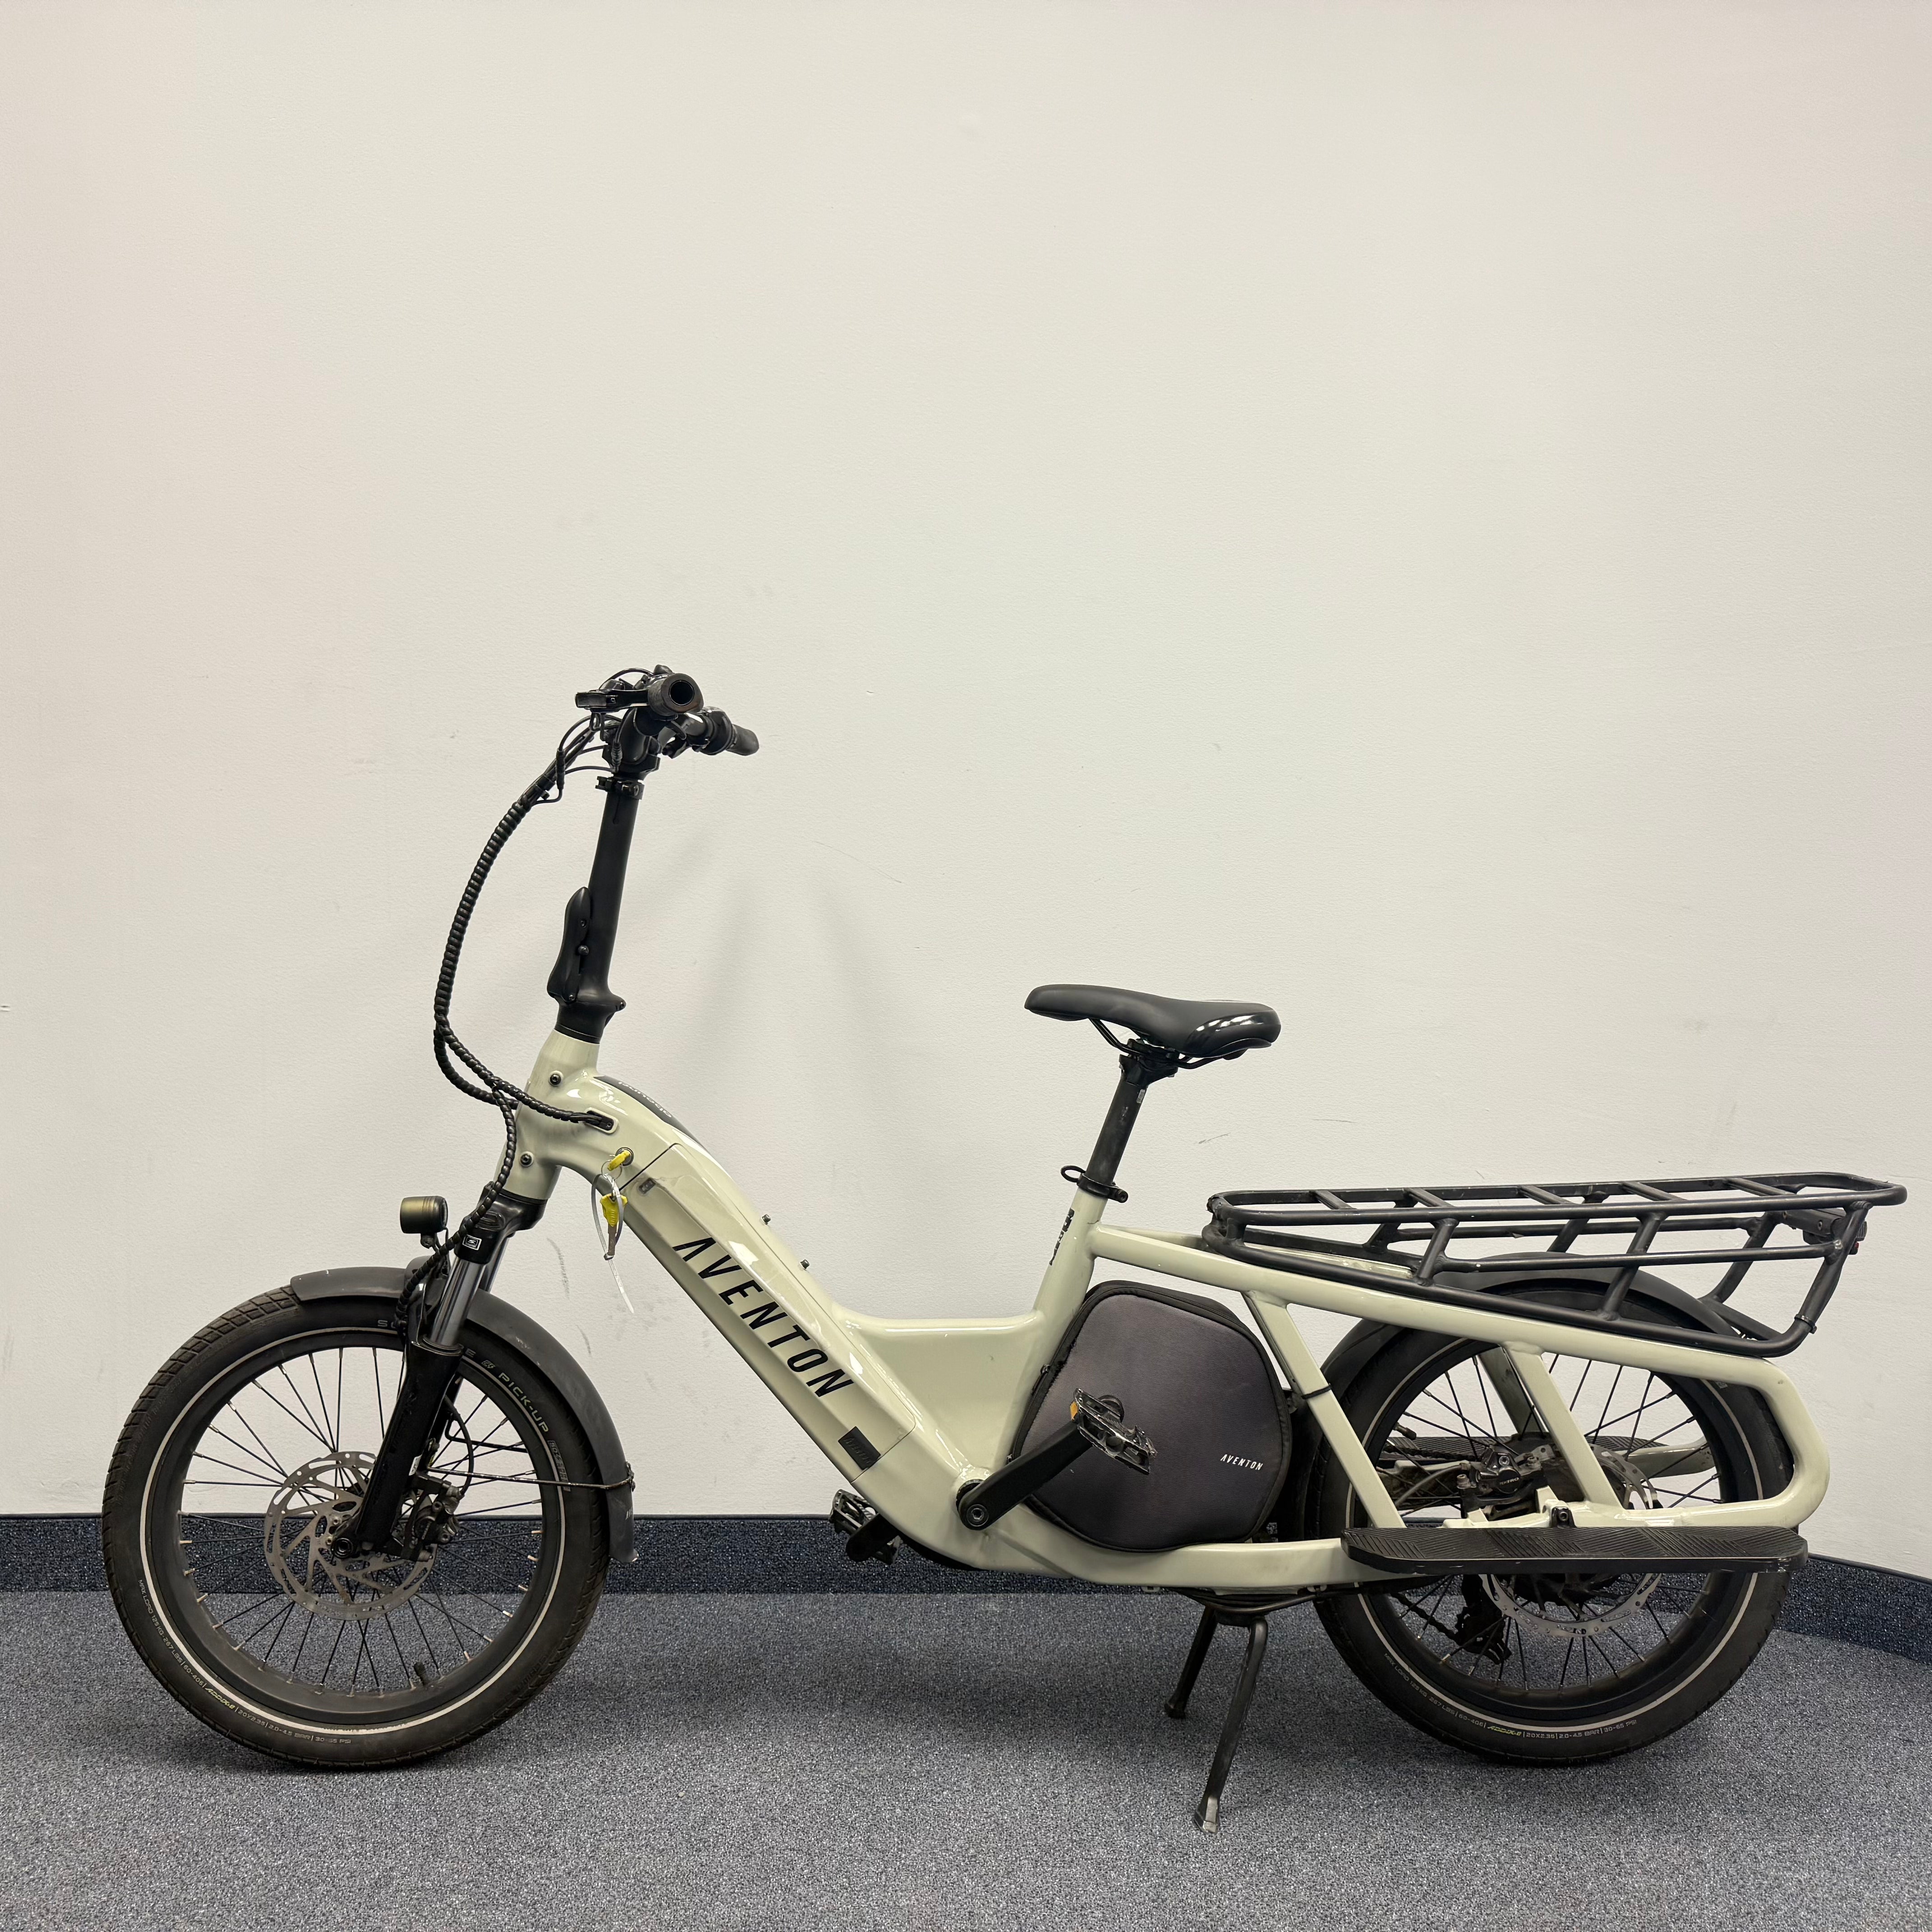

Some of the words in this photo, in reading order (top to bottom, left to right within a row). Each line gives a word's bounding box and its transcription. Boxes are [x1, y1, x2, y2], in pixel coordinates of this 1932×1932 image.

[672, 1237, 855, 1398] AVENTON
[498, 1372, 550, 1433] PICK-UP
[1220, 1454, 1264, 1471] AVENTON
[138, 1579, 147, 1594] MAX
[143, 1595, 154, 1614] LOAD
